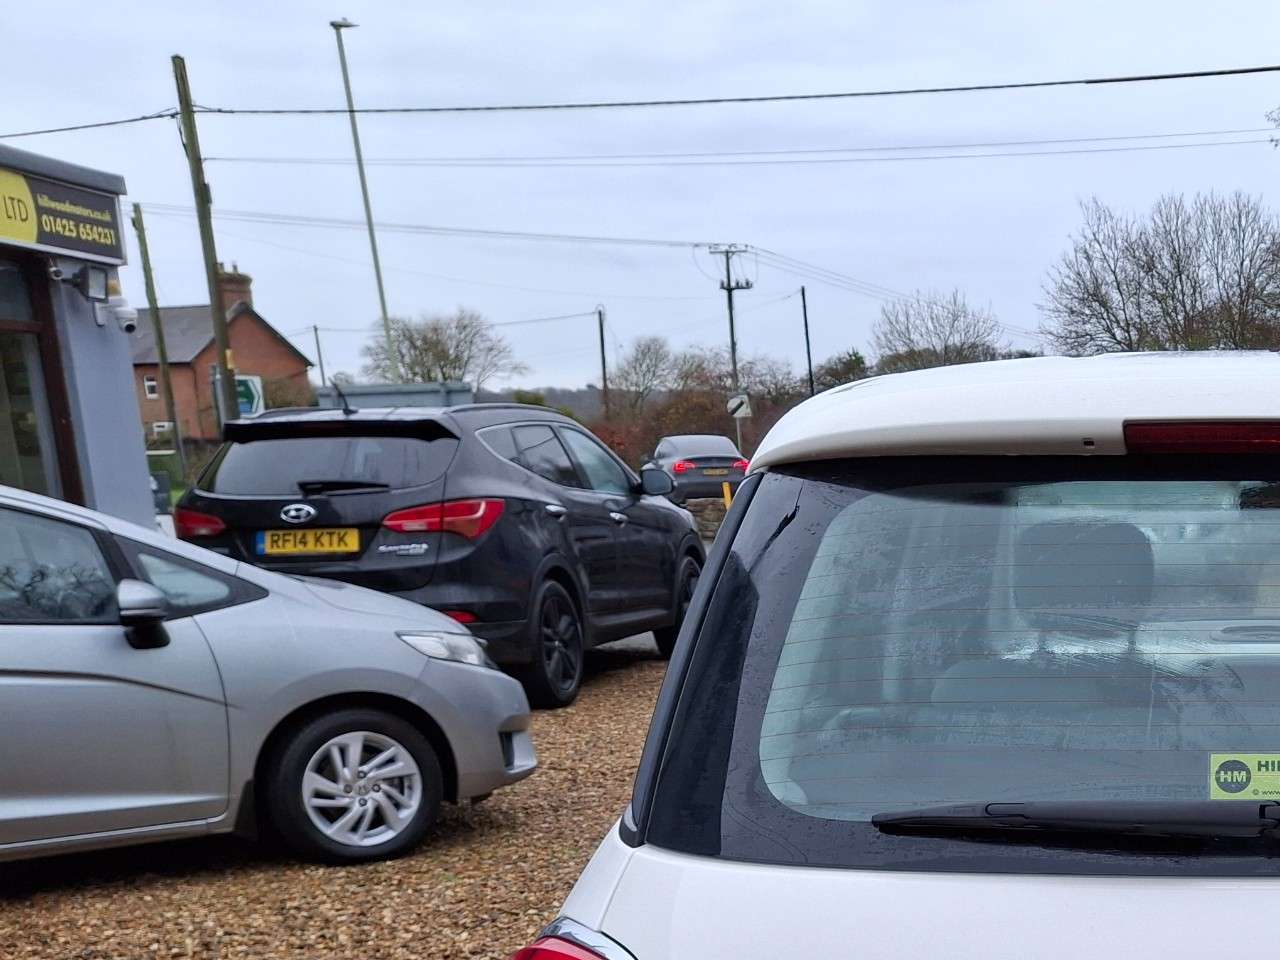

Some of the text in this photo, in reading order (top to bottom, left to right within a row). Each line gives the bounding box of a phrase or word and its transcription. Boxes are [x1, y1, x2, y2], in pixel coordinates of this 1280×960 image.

[3, 195, 29, 222] LTD
[41, 214, 116, 246] 01425 654231
[270, 531, 349, 549] RF14 KTK
[1220, 770, 1247, 783] HM
